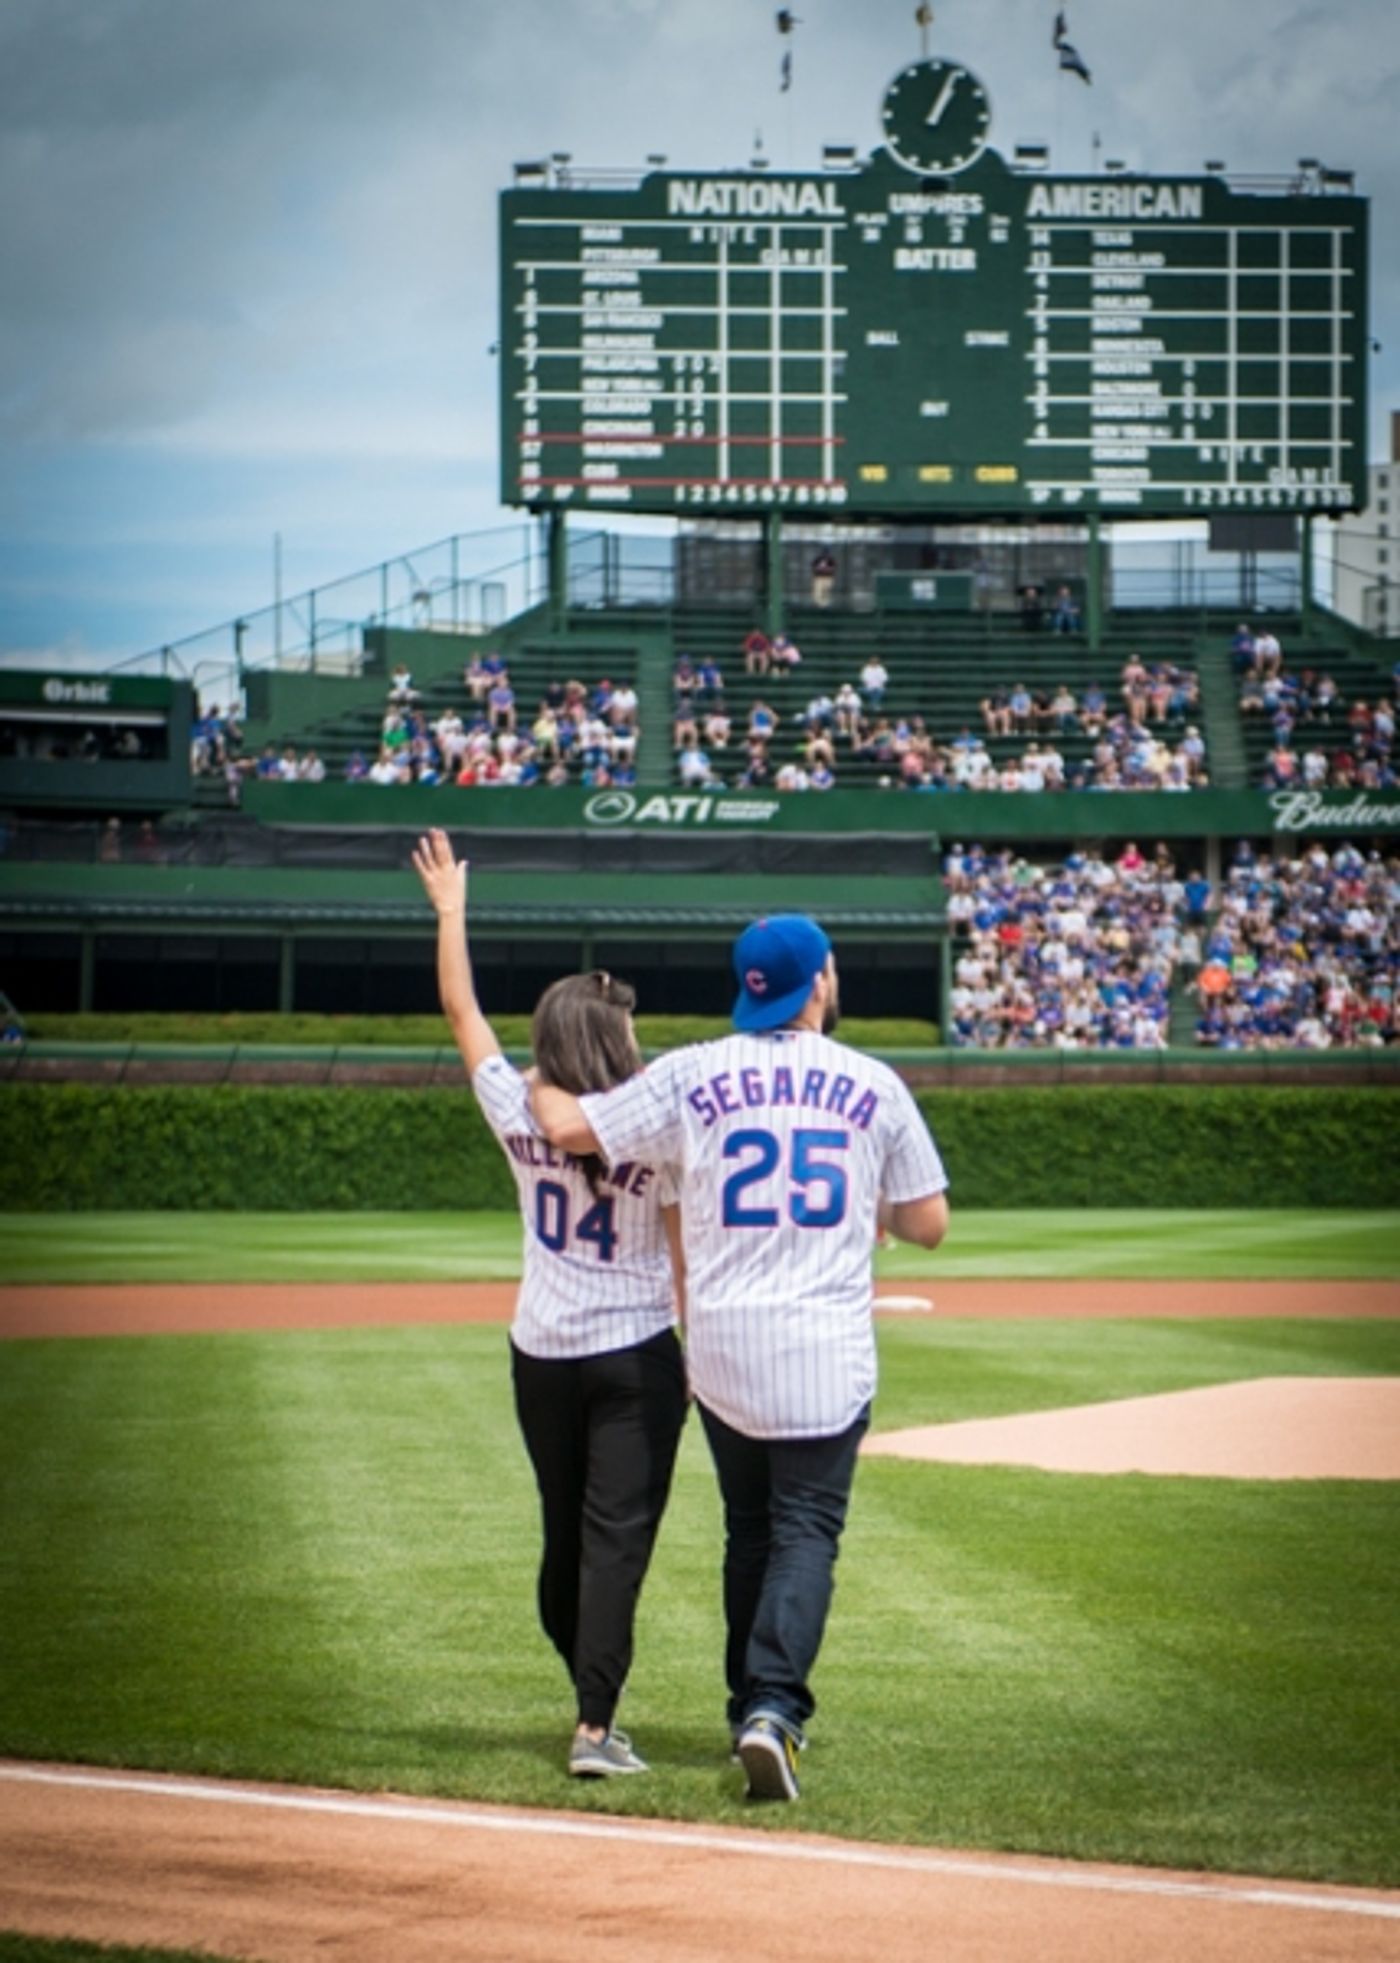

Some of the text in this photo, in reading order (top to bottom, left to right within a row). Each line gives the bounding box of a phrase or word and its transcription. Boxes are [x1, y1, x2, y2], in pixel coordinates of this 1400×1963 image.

[667, 181, 845, 215] NATIONAL
[889, 193, 984, 214] UMPIRES
[1026, 185, 1203, 217] AMERICAN
[894, 248, 977, 270] BATTER
[866, 331, 900, 346] BALL
[633, 795, 712, 822] ATI
[745, 967, 767, 994] C
[688, 1066, 879, 1130] SEGARRA
[722, 1128, 850, 1228] 25
[536, 1178, 618, 1263] 04
